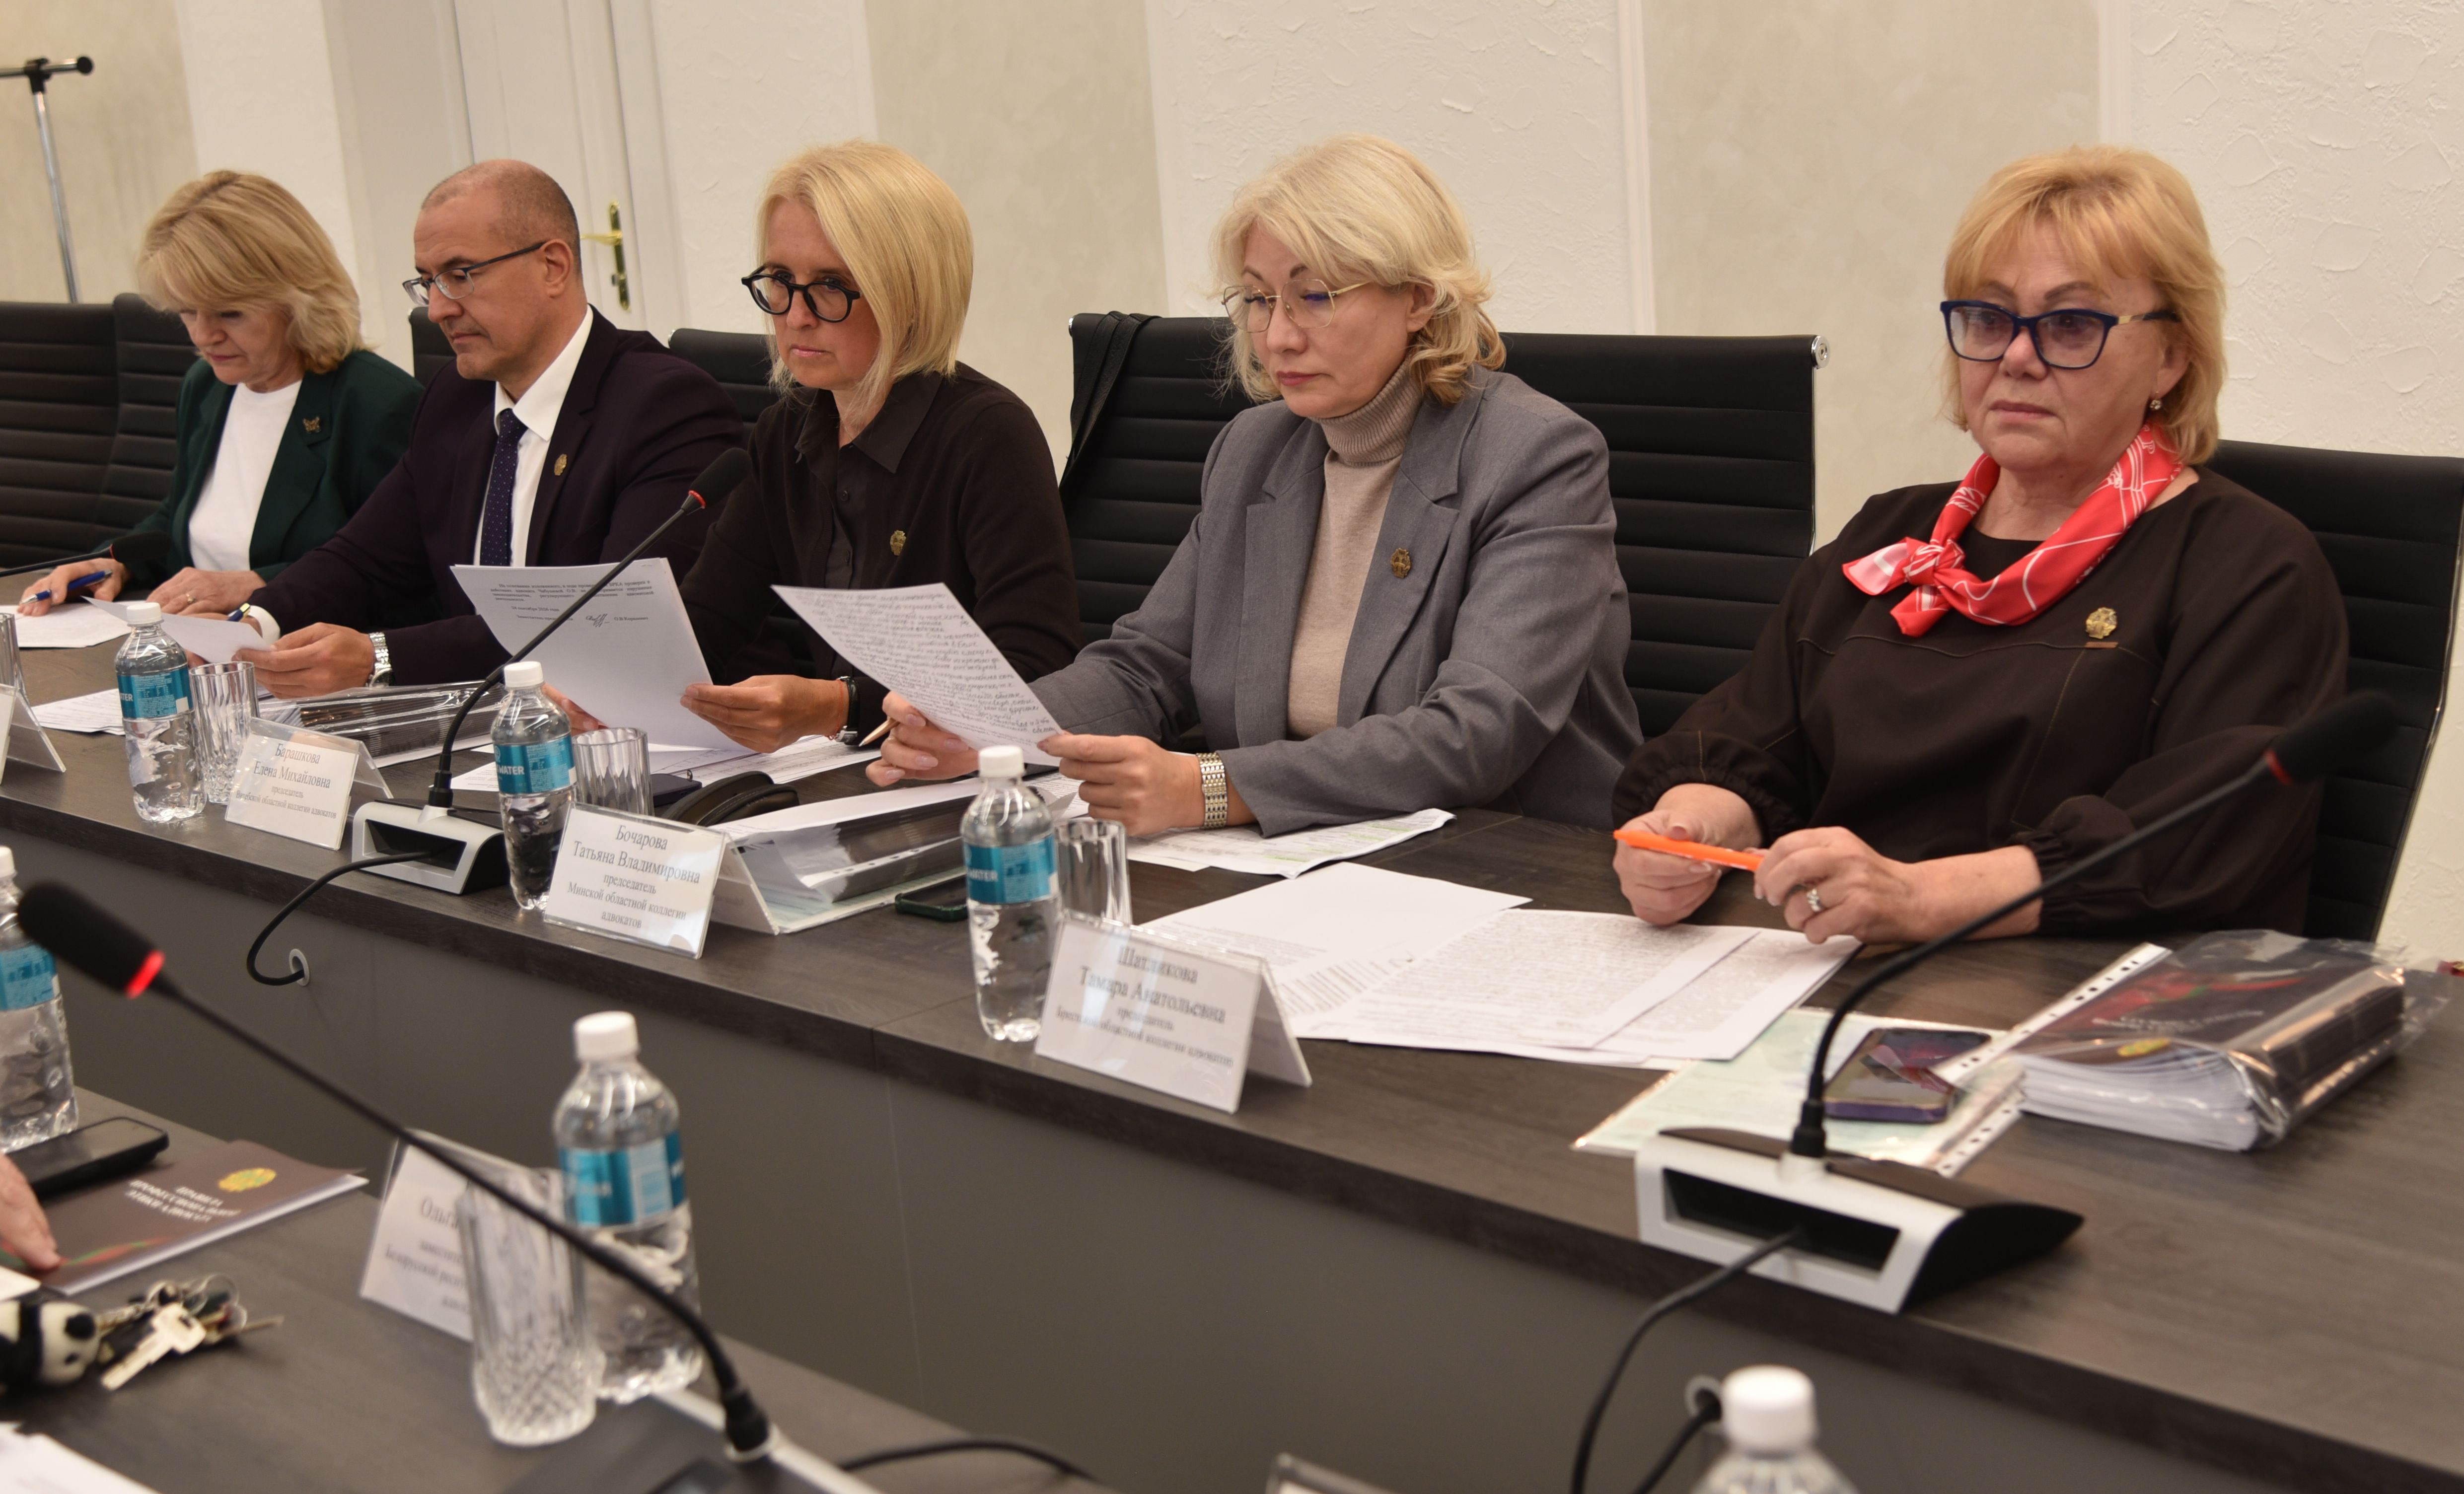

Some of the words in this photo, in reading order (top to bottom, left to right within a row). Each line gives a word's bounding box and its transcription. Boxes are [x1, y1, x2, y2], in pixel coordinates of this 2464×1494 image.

[275, 743, 321, 764] Барашкова
[253, 761, 278, 778] Елена
[279, 766, 331, 788] Михайловна
[498, 765, 525, 775] WATER
[236, 790, 261, 803] Витебской
[262, 795, 287, 808] областной
[287, 800, 311, 813] коллегии
[311, 807, 337, 819] адвокатов
[271, 786, 304, 798] председатель
[616, 825, 668, 851] Бочарова
[573, 841, 615, 864] Татьяна
[618, 851, 701, 884] Владимировна
[603, 874, 656, 895] председатель
[568, 881, 604, 901] Минской
[605, 892, 648, 911] областной
[649, 905, 687, 921] коллегии
[601, 911, 643, 929] адвокатов
[1079, 965, 1129, 999] Тамара
[1131, 983, 1227, 1025] Анатольевна
[1099, 1020, 1144, 1041] областной
[1145, 1034, 1187, 1053] коллегии
